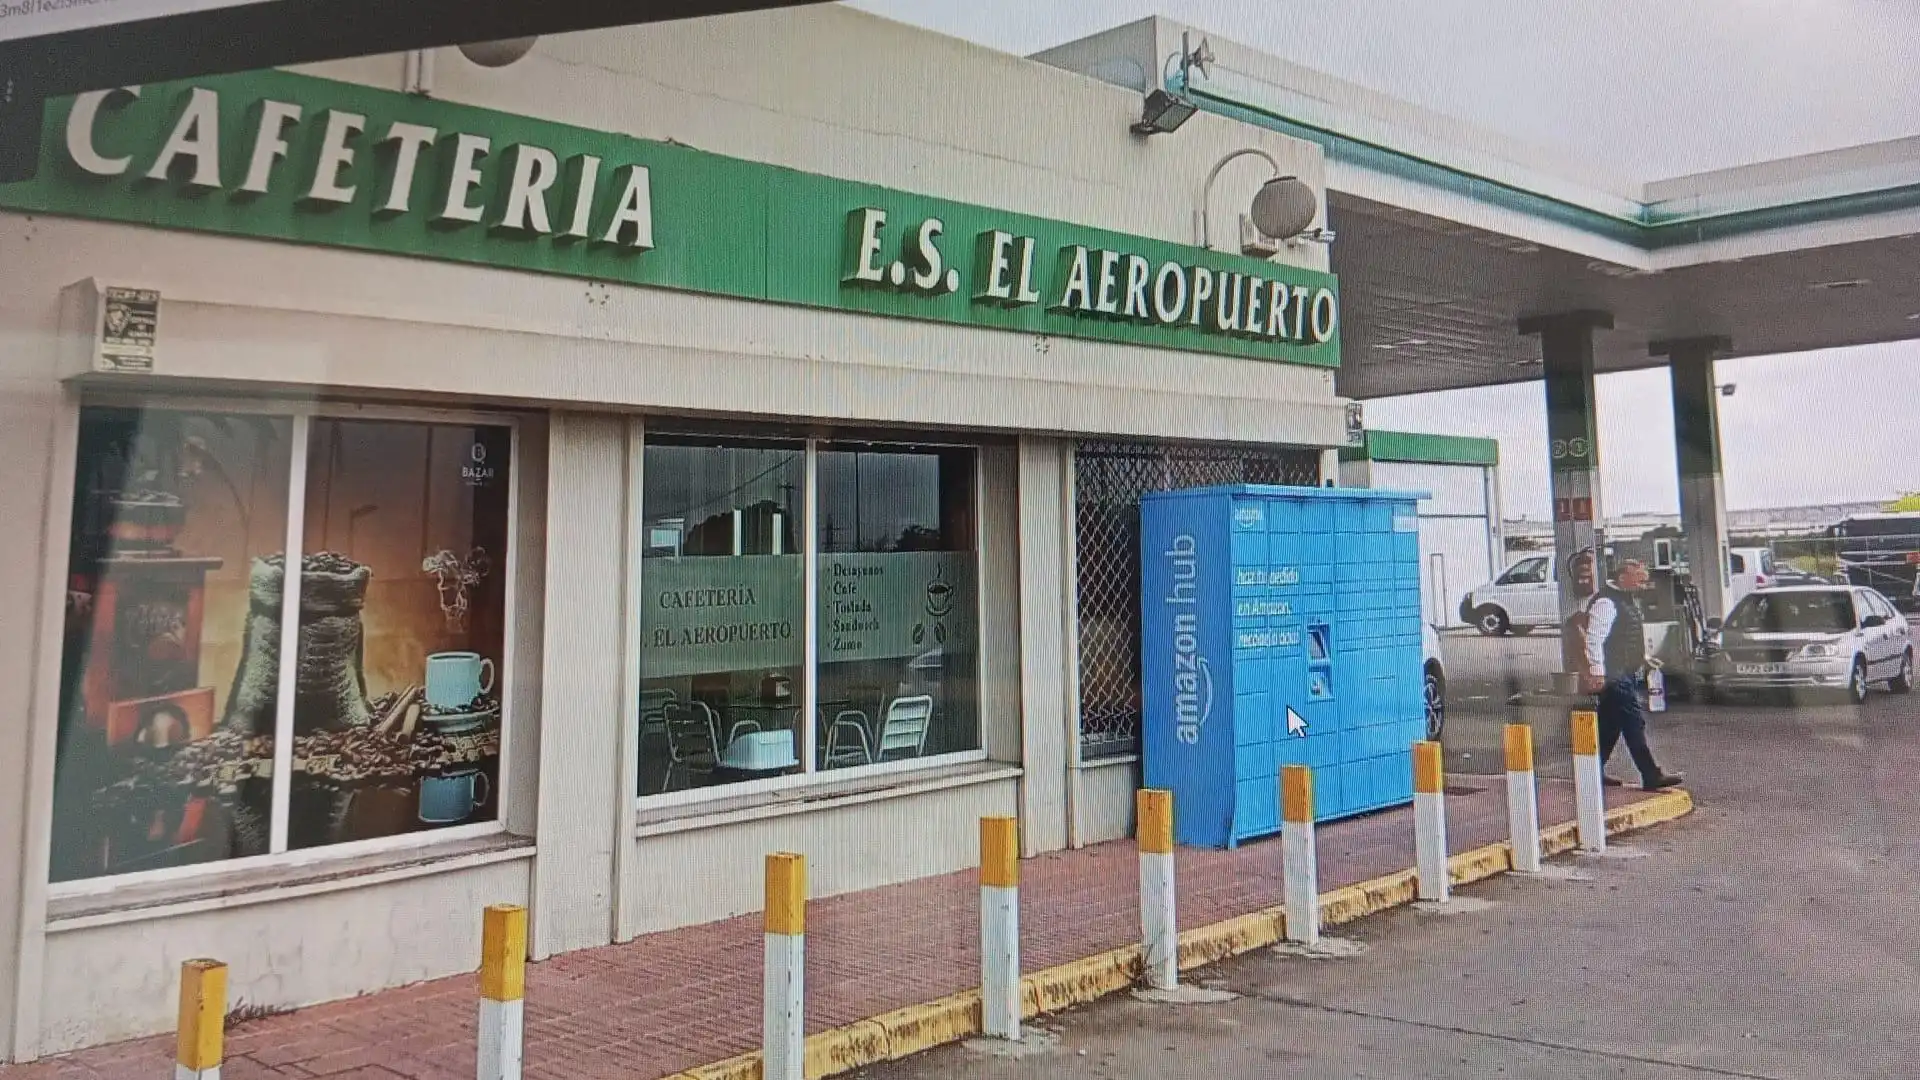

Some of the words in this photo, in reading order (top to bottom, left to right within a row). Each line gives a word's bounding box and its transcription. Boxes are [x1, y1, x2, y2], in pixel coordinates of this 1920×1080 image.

[65, 84, 655, 249] CAFETERIA
[856, 207, 960, 293] E.S.
[986, 230, 1040, 303] EL
[1060, 245, 1336, 343] AEROPUERTO
[833, 581, 857, 595] Café
[1166, 534, 1196, 603] hub
[653, 628, 676, 648] EL
[680, 621, 792, 646] AEROPUERTO
[832, 637, 863, 651] Zumo
[1174, 613, 1200, 745] amazon
